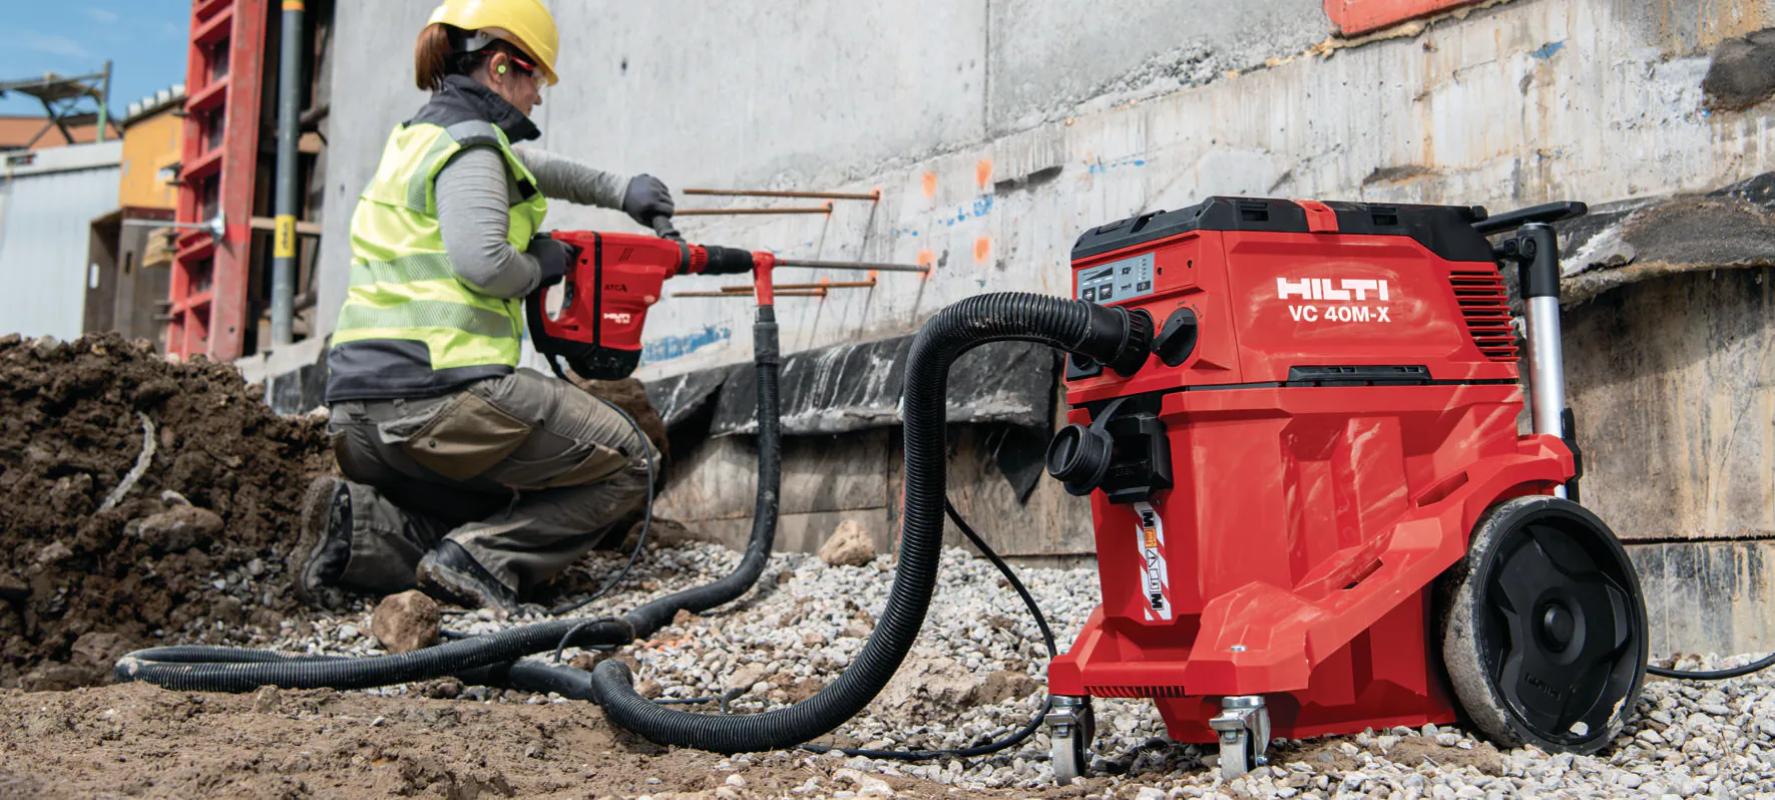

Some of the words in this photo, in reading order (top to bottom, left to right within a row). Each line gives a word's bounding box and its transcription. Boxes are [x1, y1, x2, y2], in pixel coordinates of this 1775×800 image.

[1276, 277, 1389, 301] HILTI
[1288, 304, 1319, 322] VC
[1324, 305, 1391, 322] 40M-X
